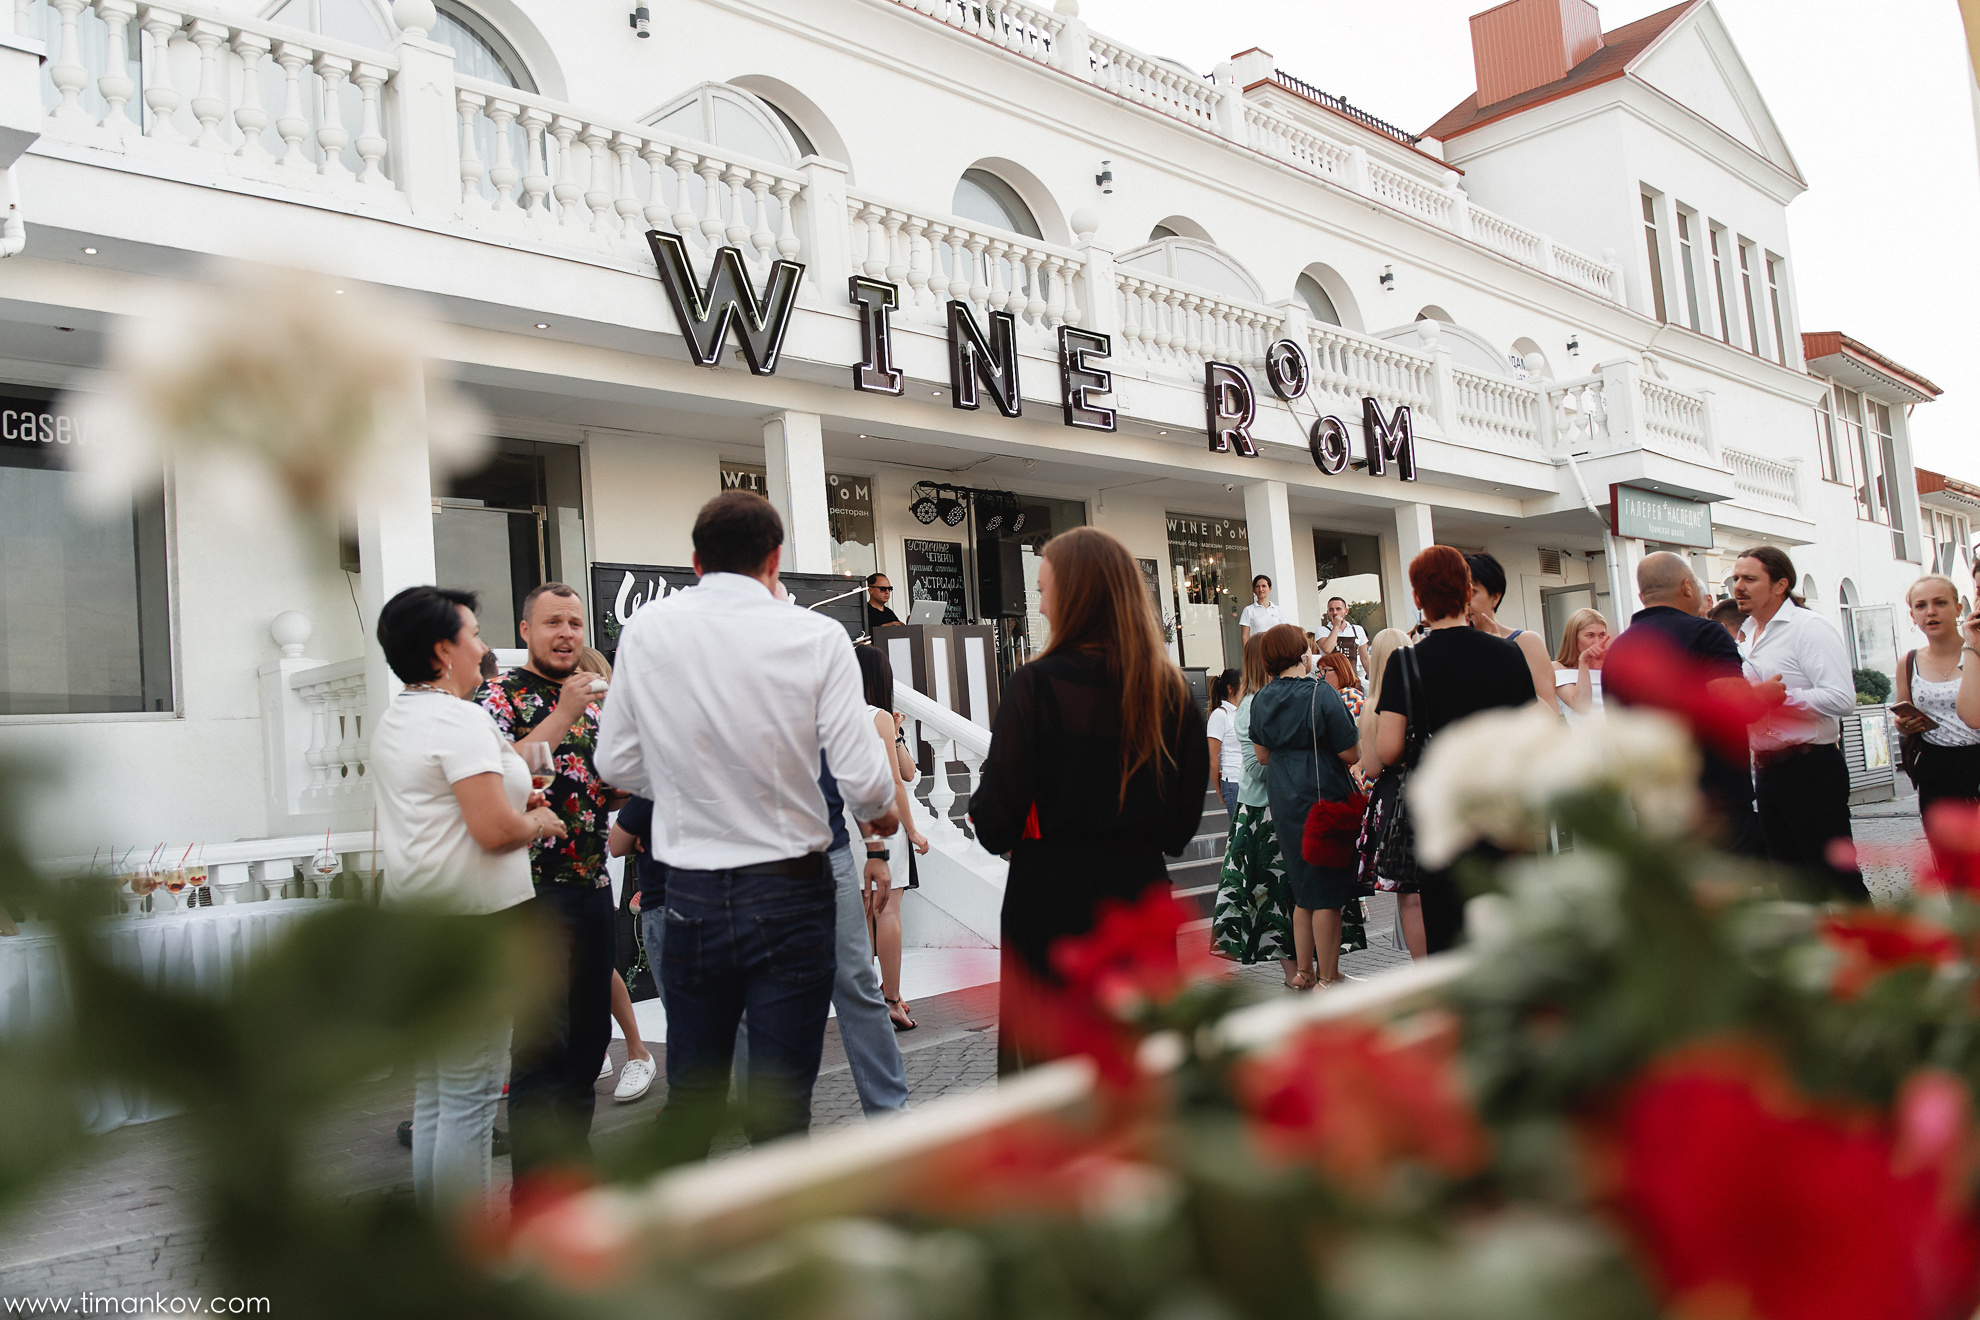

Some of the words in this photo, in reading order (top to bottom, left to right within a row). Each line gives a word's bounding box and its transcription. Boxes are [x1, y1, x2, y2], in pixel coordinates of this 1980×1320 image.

[646, 230, 1117, 433] WINE
[1205, 339, 1417, 481] ROOM
[829, 507, 869, 517] ресторан
[1625, 499, 1662, 521] ГАЛЕРЕЯ
[1166, 519, 1208, 536] WINE
[1215, 520, 1247, 540] ROOM
[1671, 528, 1685, 537] школа
[1225, 544, 1249, 552] ресторан
